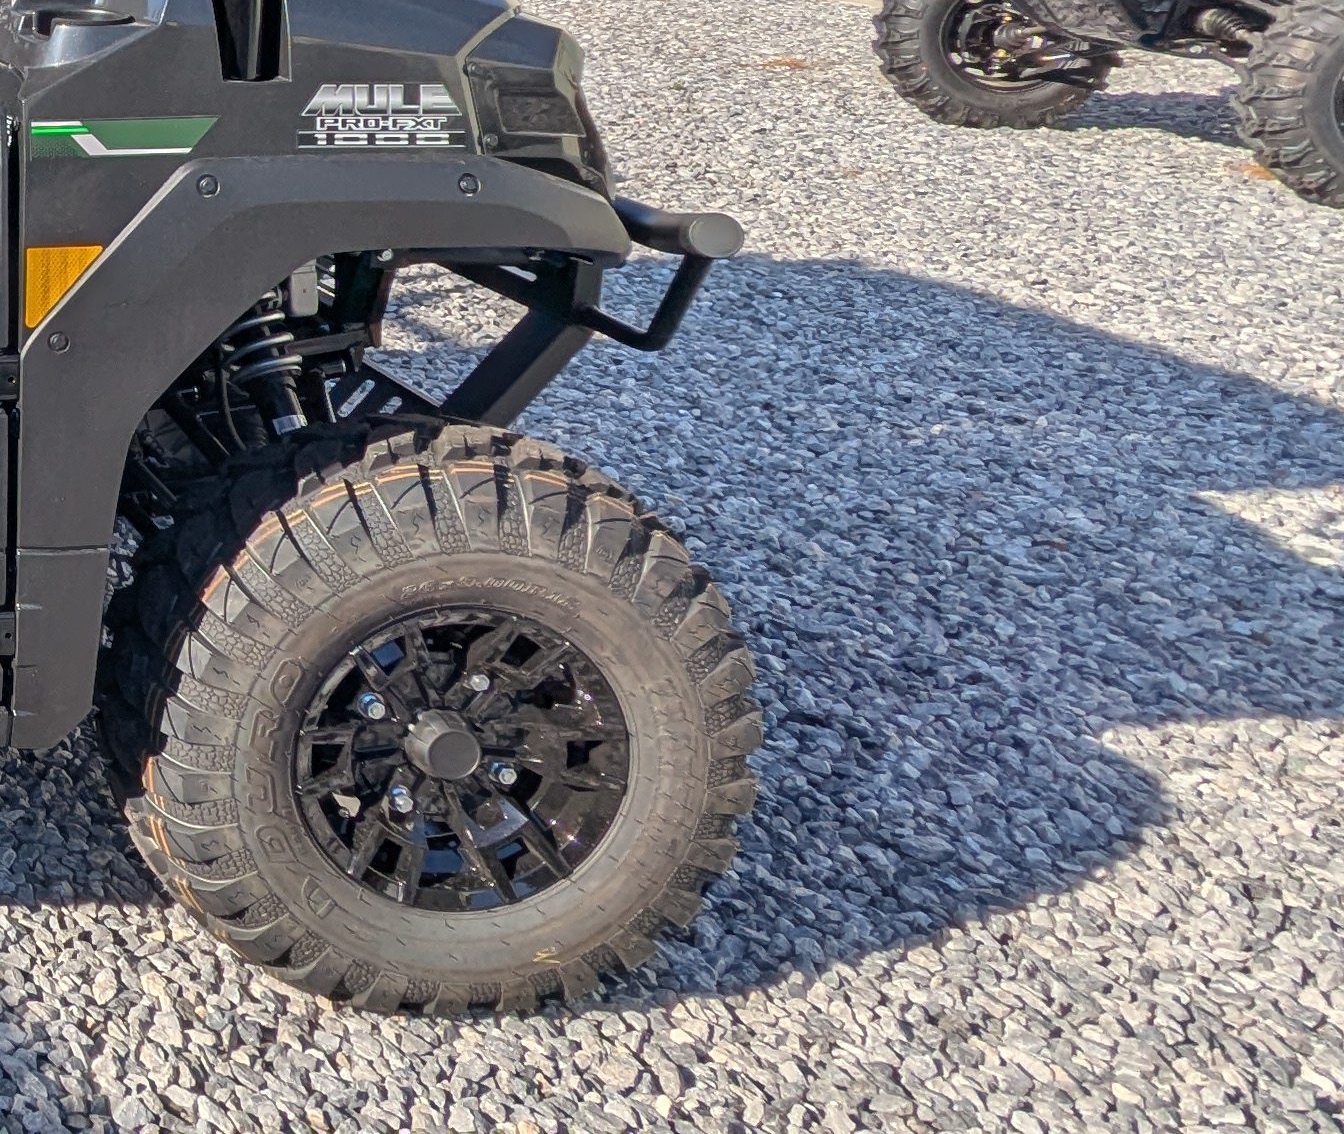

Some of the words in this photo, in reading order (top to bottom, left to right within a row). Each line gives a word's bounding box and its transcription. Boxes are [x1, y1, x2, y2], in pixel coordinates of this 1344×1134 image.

[301, 83, 463, 116] MULE
[316, 116, 448, 131] PRO-FXT
[314, 133, 450, 145] 1000
[245, 657, 303, 864] DURO
